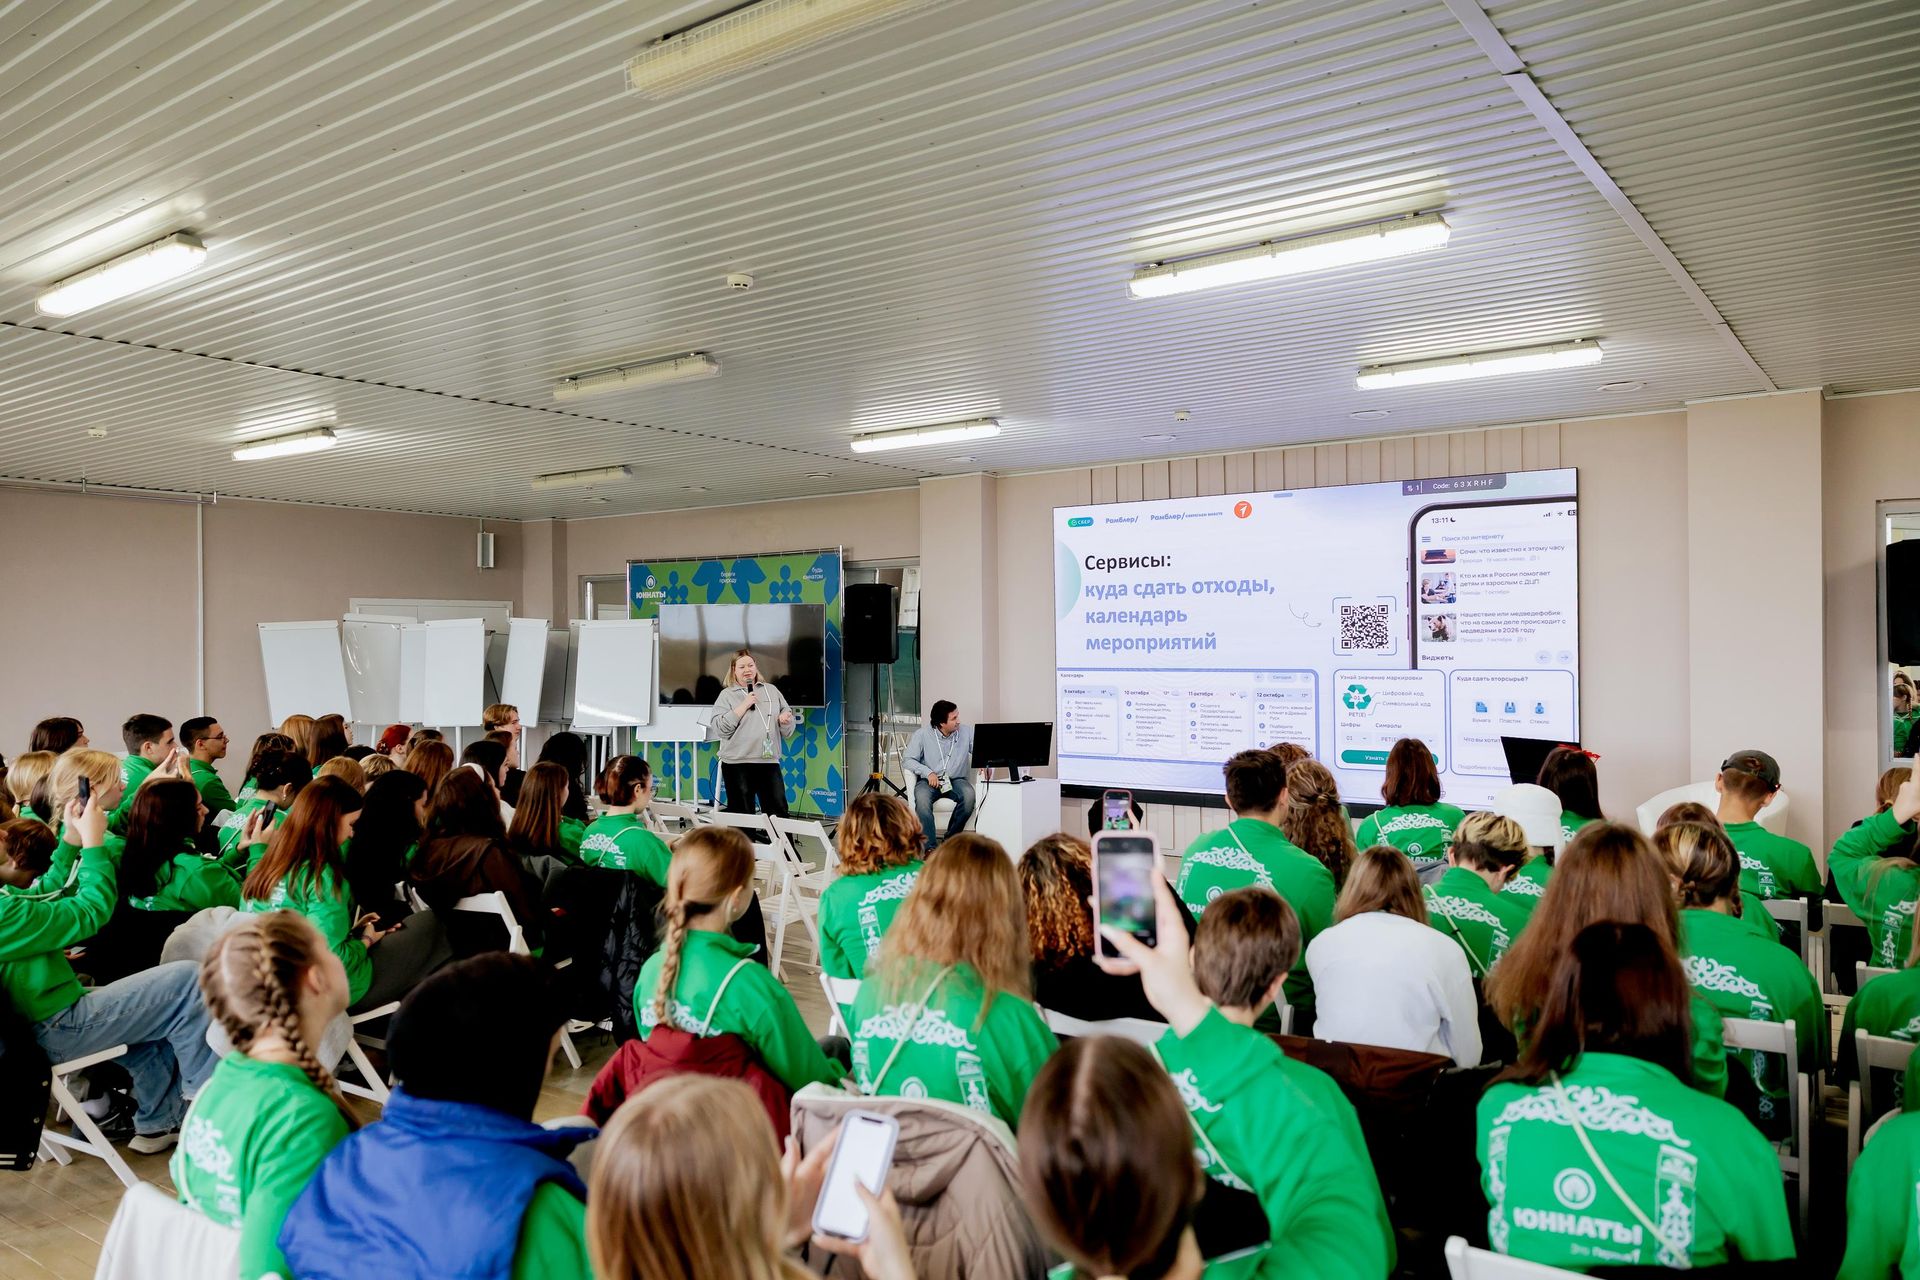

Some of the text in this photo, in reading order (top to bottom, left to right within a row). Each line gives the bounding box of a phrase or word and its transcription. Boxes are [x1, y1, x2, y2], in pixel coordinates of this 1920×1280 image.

[1454, 479, 1494, 489] 63XRHF
[1084, 554, 1172, 573] Сервисы:
[636, 591, 666, 599] ЮННАТЫ
[1085, 578, 1275, 600] куда сдать отходы,
[1085, 609, 1188, 626] календарь
[1085, 632, 1217, 653] мероприятий
[1513, 1206, 1643, 1246] ЮННАТЫ
